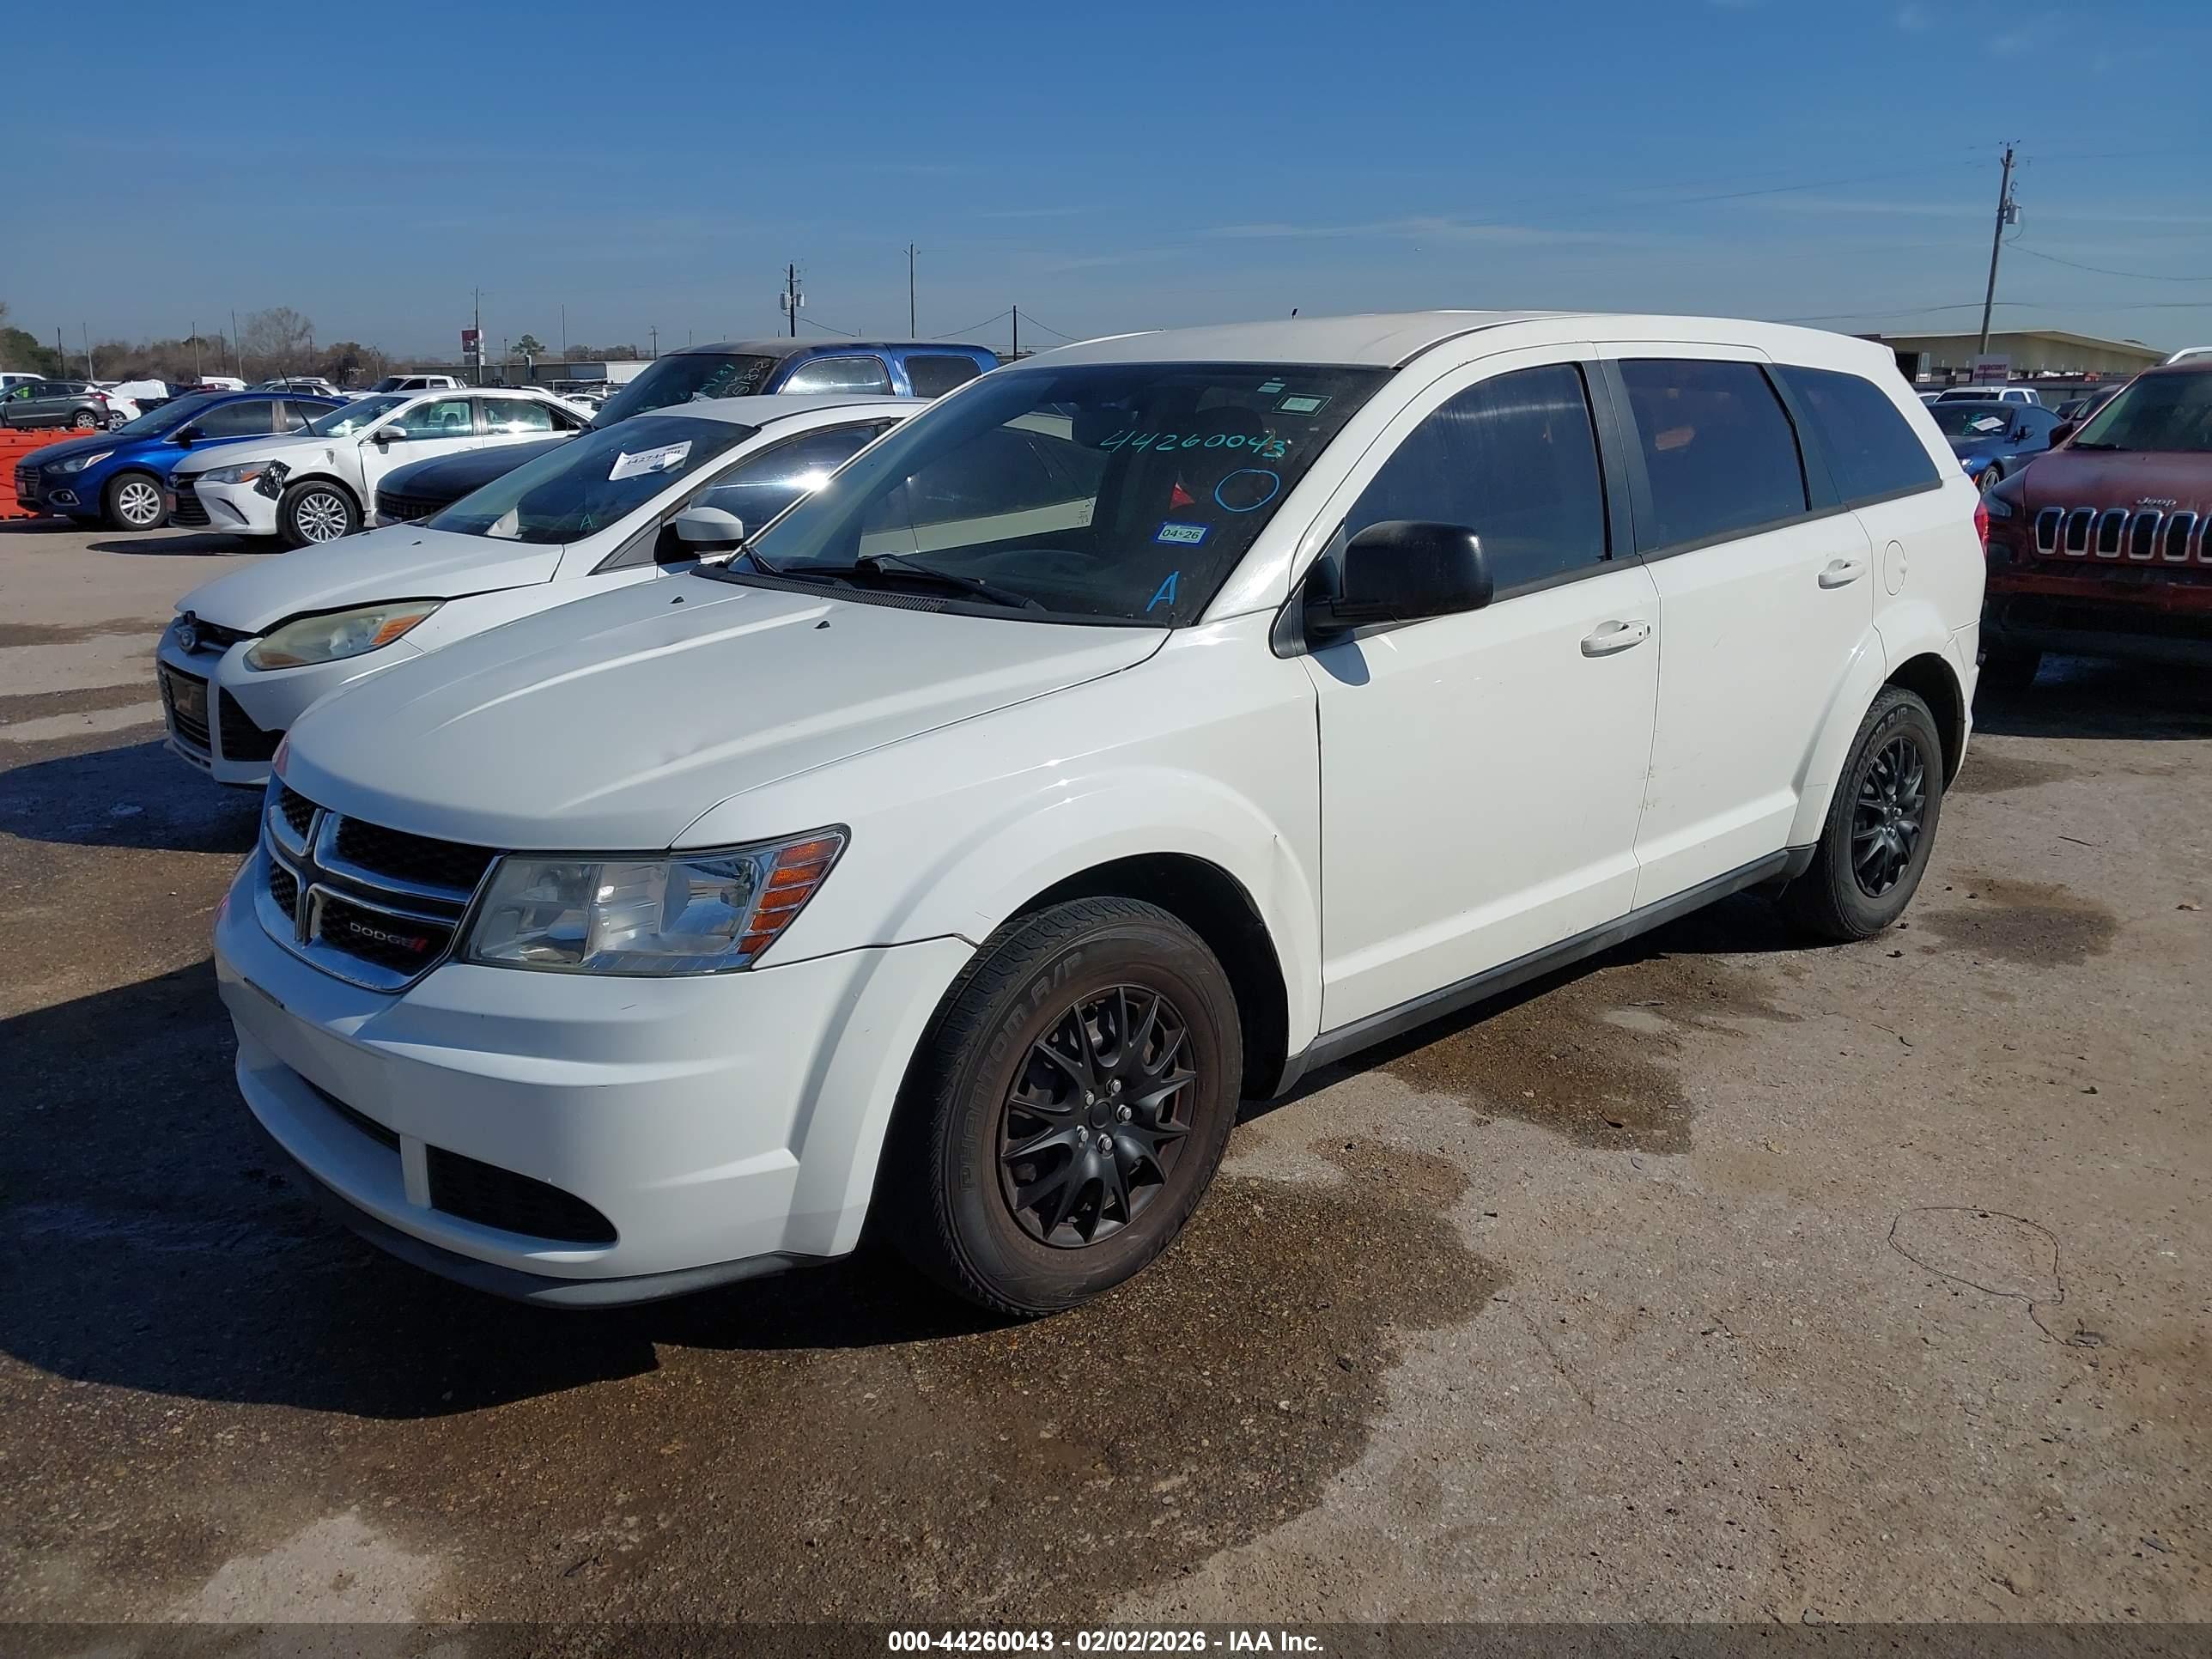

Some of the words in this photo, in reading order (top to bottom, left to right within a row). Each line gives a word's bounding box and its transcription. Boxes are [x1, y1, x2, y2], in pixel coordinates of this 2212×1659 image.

[1100, 430, 1286, 458] 44260043
[579, 514, 594, 531] A
[1146, 570, 1179, 612] A
[349, 921, 415, 949] DODGE
[959, 1003, 1030, 1193] PHANTOM
